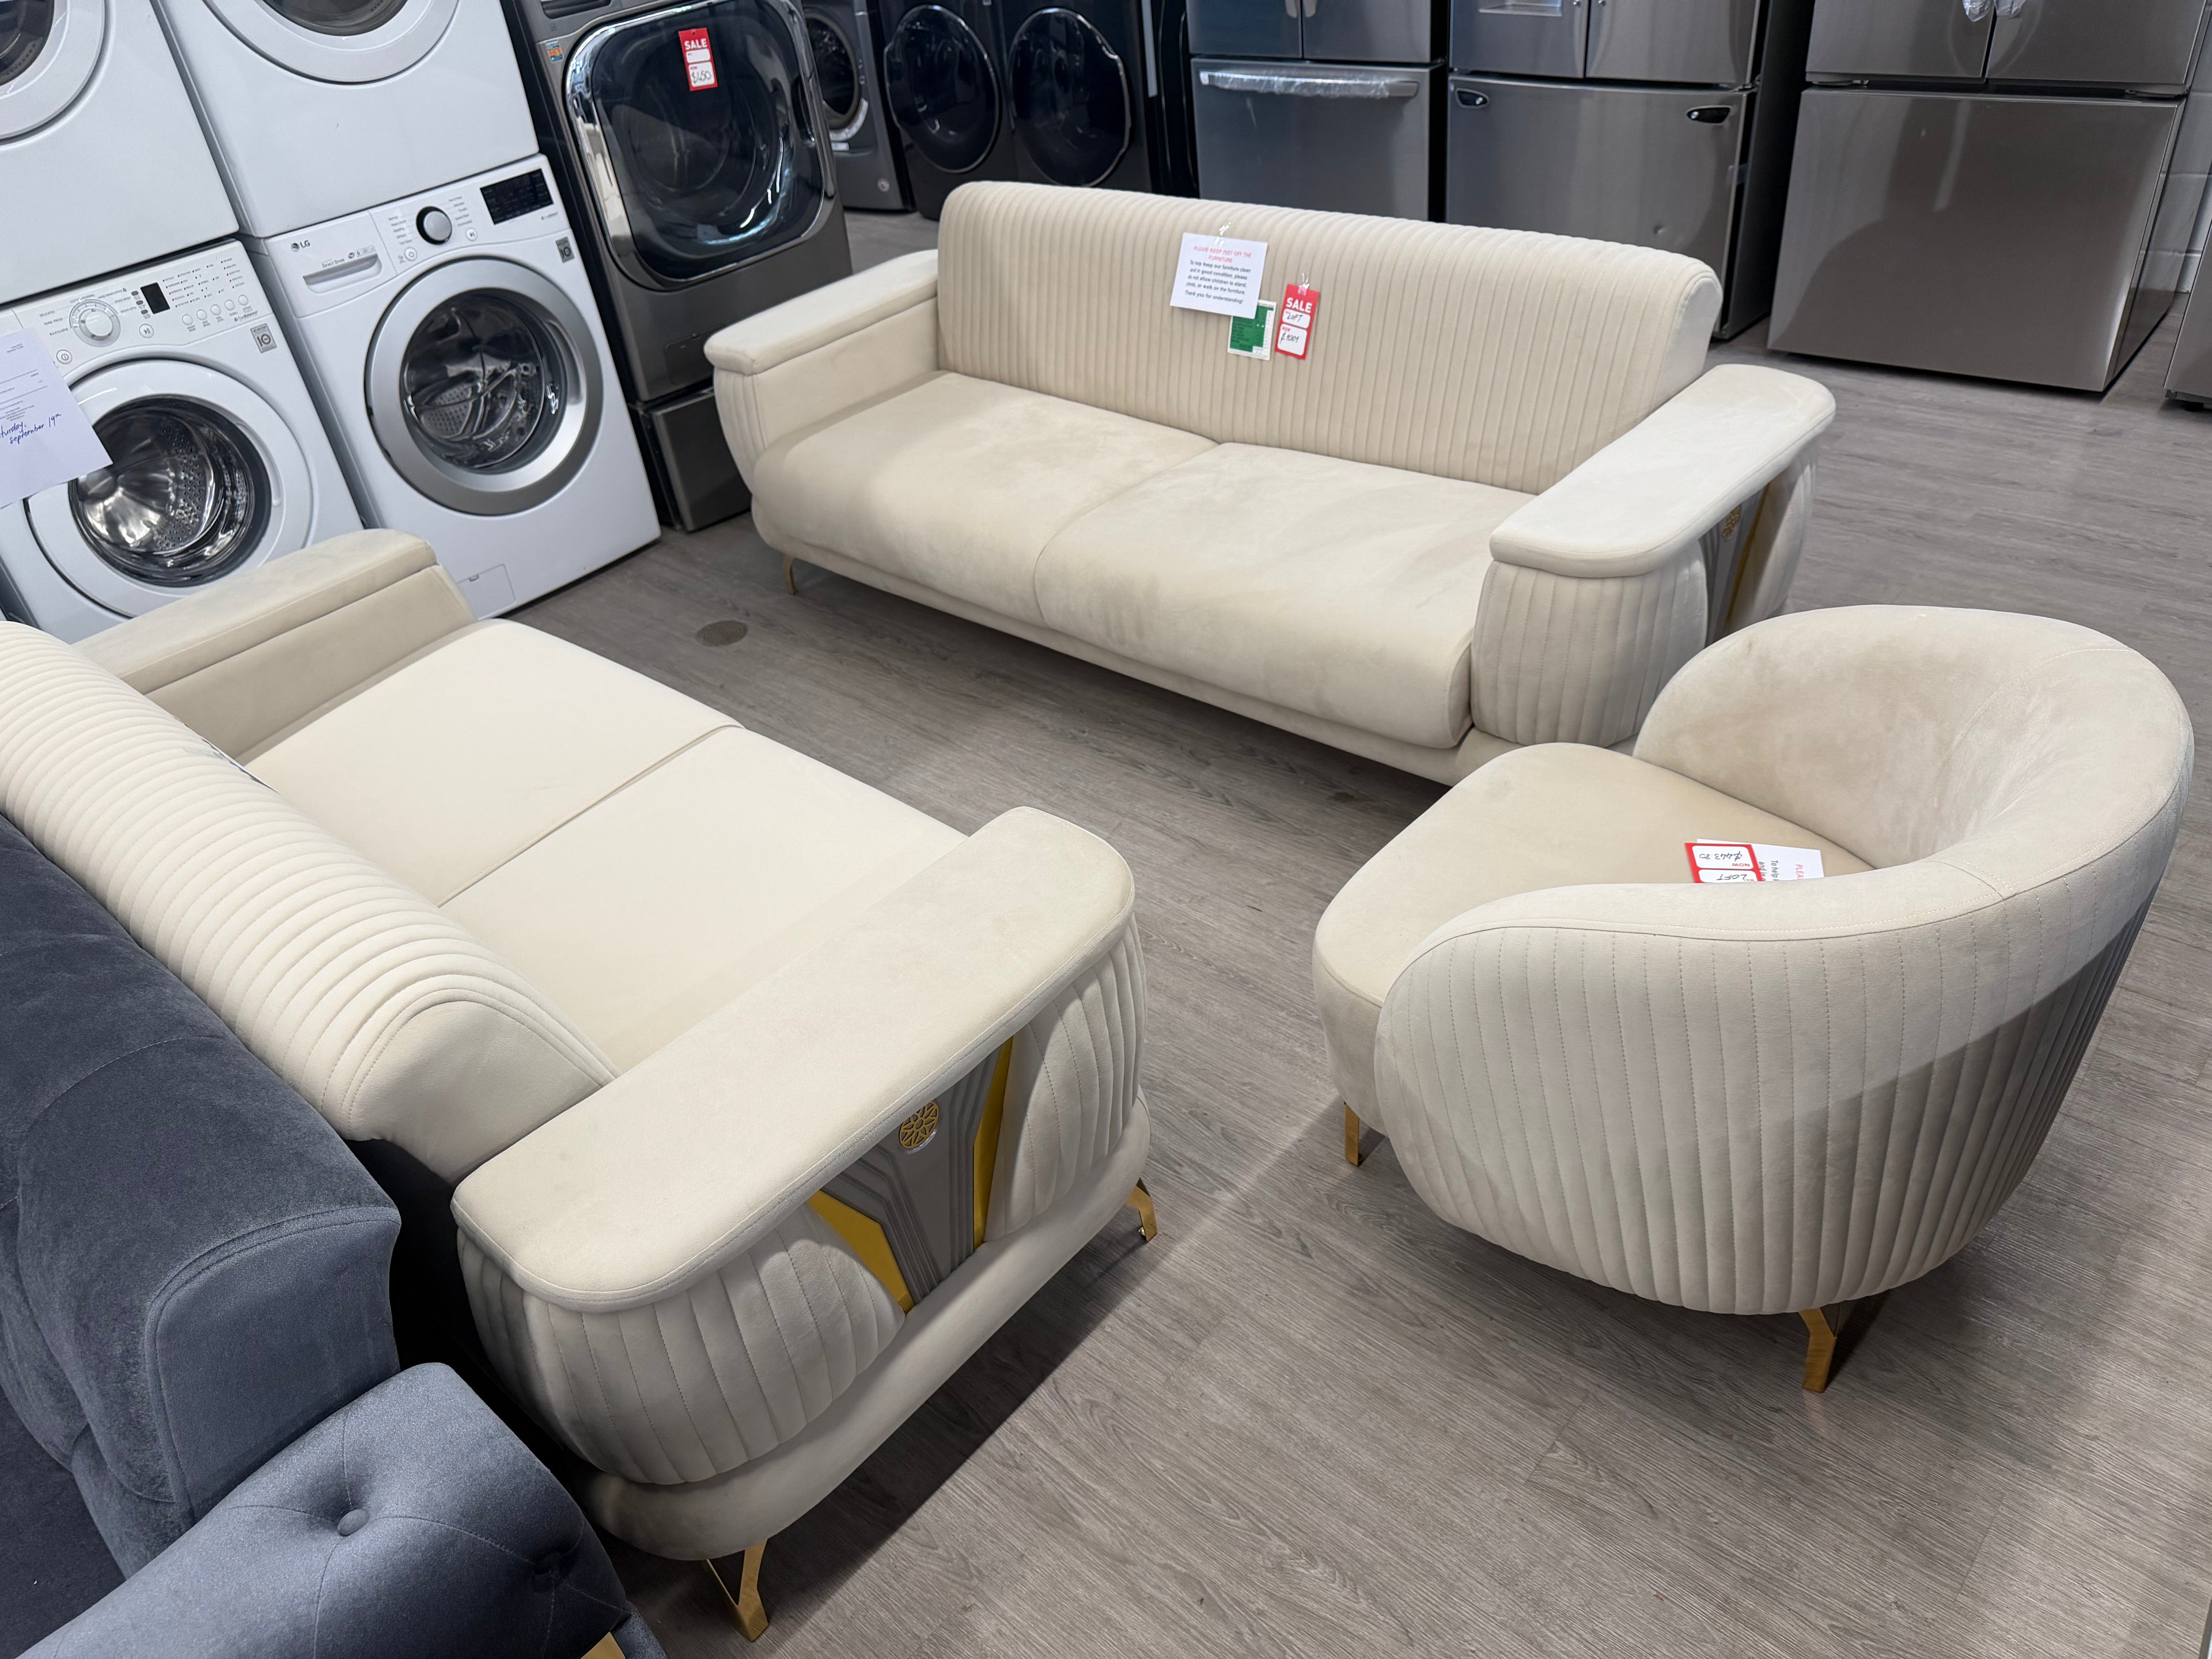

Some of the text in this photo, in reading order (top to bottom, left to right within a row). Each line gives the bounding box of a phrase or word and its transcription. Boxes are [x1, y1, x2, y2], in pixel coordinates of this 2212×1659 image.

[684, 38, 708, 50] SALE
[1286, 297, 1313, 313] SALE
[1770, 867, 1779, 878] help
[1795, 863, 1804, 880] PLEA
